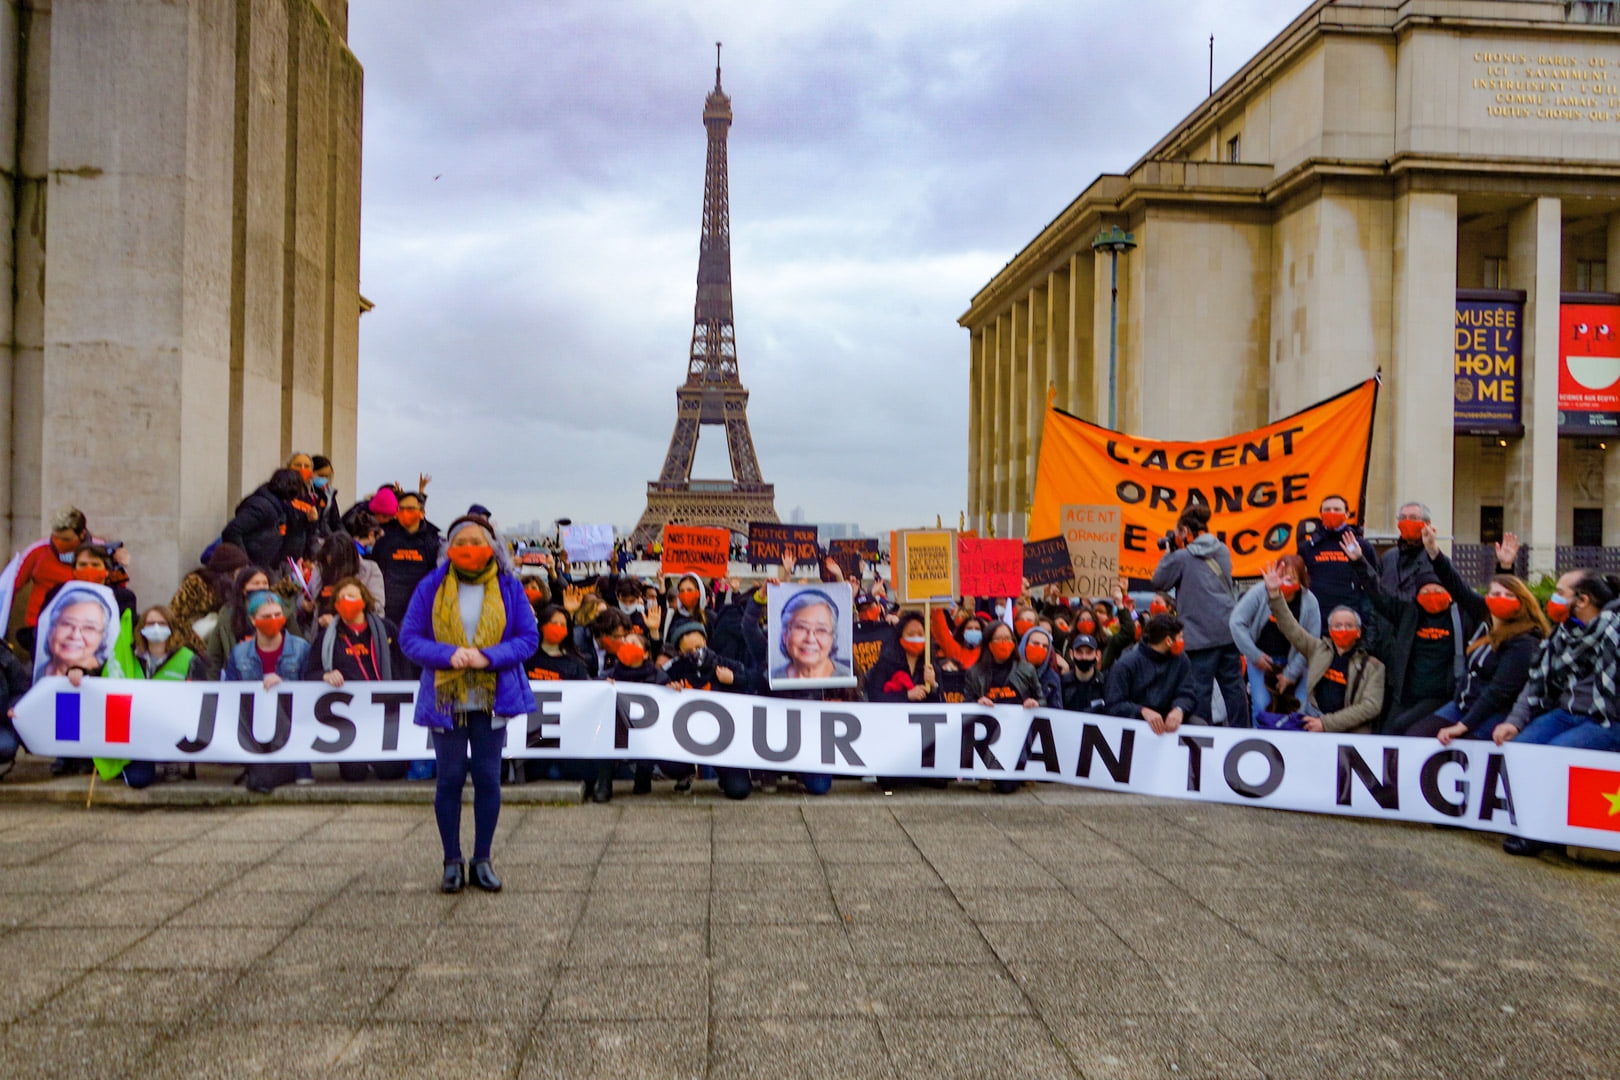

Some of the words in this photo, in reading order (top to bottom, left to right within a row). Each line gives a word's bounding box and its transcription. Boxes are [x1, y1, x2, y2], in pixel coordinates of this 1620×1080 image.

[1474, 52, 1526, 64] CHOSES
[1538, 55, 1577, 65] RARES
[1487, 65, 1508, 76] ICI
[1525, 68, 1608, 81] SAVAMMENT
[1473, 79, 1565, 92] INSTRUISENT
[1496, 93, 1543, 105] COMME
[1487, 105, 1529, 117] TOUTES
[1537, 109, 1580, 120] CHOSES
[1589, 111, 1608, 122] QUI
[1456, 307, 1516, 328] MUSÉE
[1455, 328, 1487, 351] DE
[1495, 330, 1513, 352] L'
[1478, 379, 1515, 402] ME
[1107, 427, 1303, 470] L'AGENT
[1116, 474, 1309, 513] ORANGE
[1066, 509, 1116, 523] AGENT
[668, 533, 684, 546] NOS
[687, 534, 721, 546] TERRES
[752, 527, 788, 540] JUSTICE
[794, 531, 815, 541] POUR
[1067, 529, 1117, 543] ORANGE
[752, 541, 780, 559] TRAN
[176, 691, 562, 753] JUSTE
[614, 693, 866, 767] POUR
[909, 713, 1135, 784] TRAN
[1178, 736, 1285, 798] TO
[1336, 744, 1518, 826] NGA
